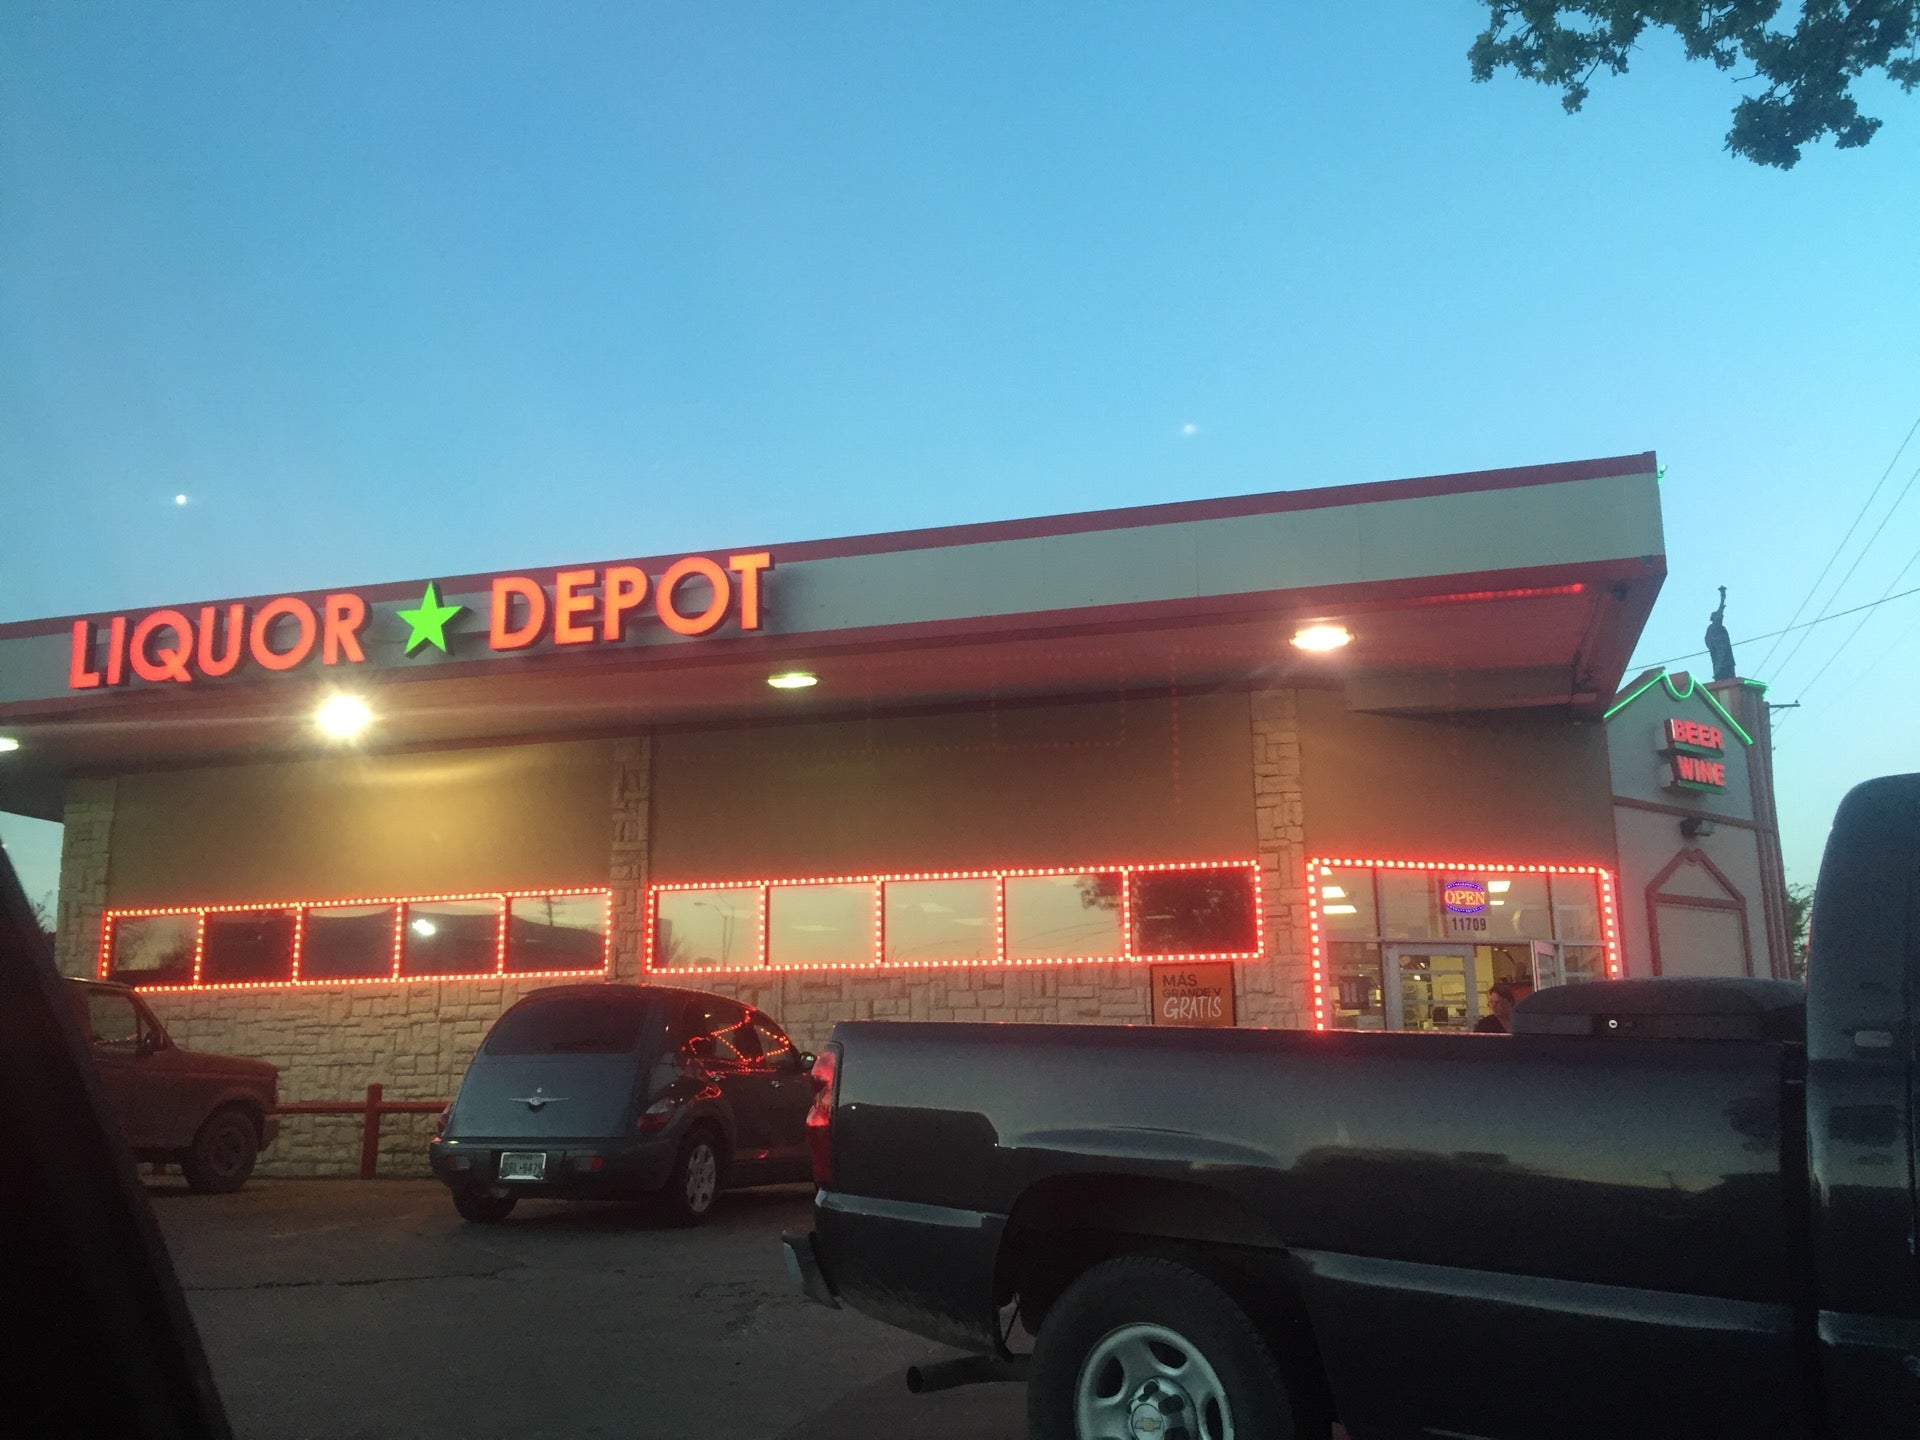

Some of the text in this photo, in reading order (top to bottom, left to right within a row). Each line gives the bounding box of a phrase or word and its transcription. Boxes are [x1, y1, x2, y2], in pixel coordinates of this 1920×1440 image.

[69, 552, 771, 690] LIQUOR DEPOT
[1671, 718, 1724, 750] BEER
[1676, 755, 1726, 787] WINE
[1444, 890, 1486, 905] OPEN
[1452, 917, 1487, 931] 11709
[1162, 988, 1210, 998] GRANDE
[1163, 996, 1222, 1019] GRATIS
